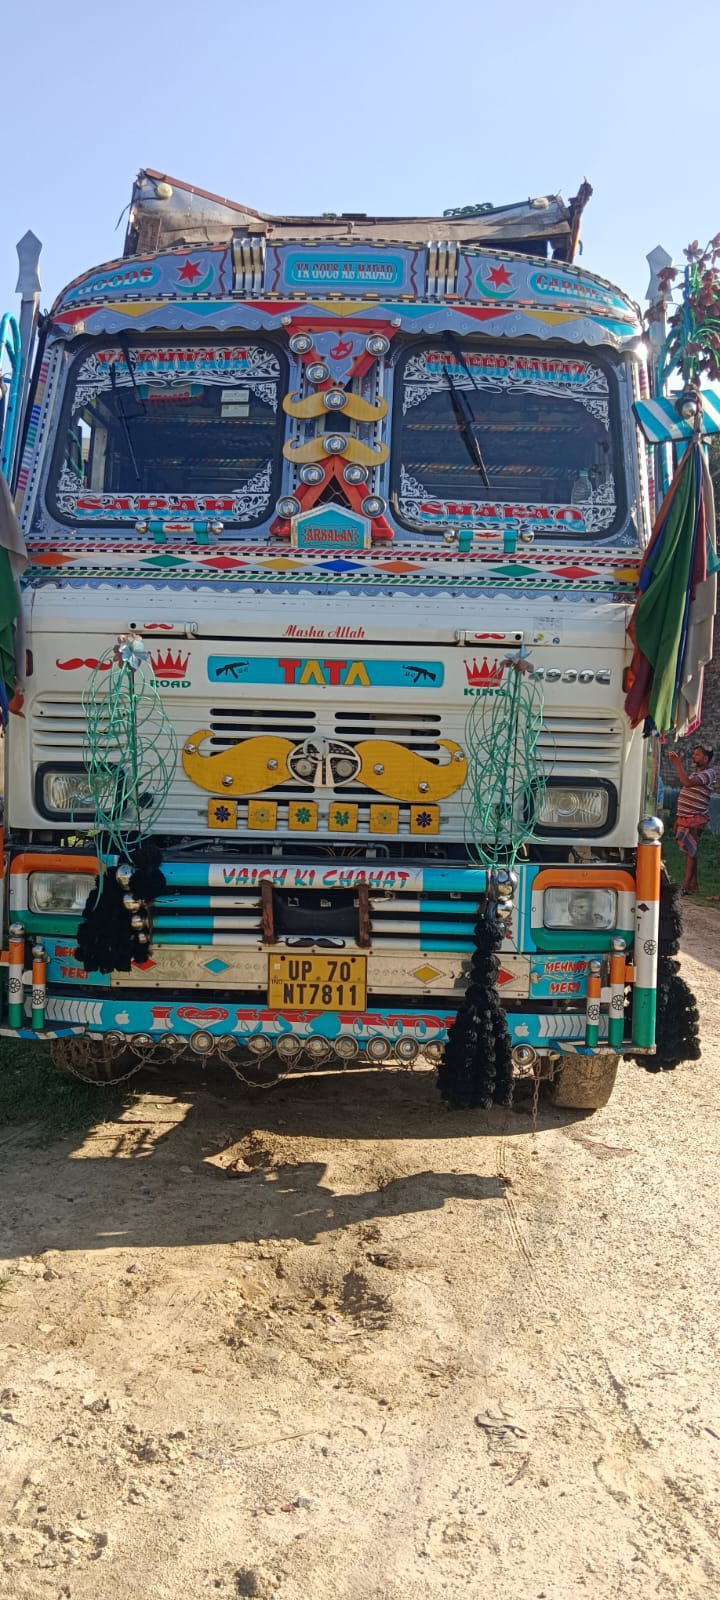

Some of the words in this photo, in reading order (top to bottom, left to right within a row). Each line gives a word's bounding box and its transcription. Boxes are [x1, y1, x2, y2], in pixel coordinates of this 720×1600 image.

[296, 263, 310, 279] YA
[536, 273, 613, 304] CARRIER
[73, 498, 239, 518] SARAH
[306, 527, 354, 542] ARSALAN
[282, 624, 325, 638] Masha
[327, 626, 366, 639] Allah
[278, 659, 371, 686] TATA
[150, 679, 192, 689] ROAD
[463, 688, 509, 697] KING
[294, 868, 316, 886] KI
[322, 869, 410, 889] CHAHAT
[288, 960, 312, 981] UP
[327, 961, 351, 982] 70
[544, 961, 588, 973] MEHNAT
[283, 983, 357, 1006] NT7811
[550, 982, 581, 993] MERI
